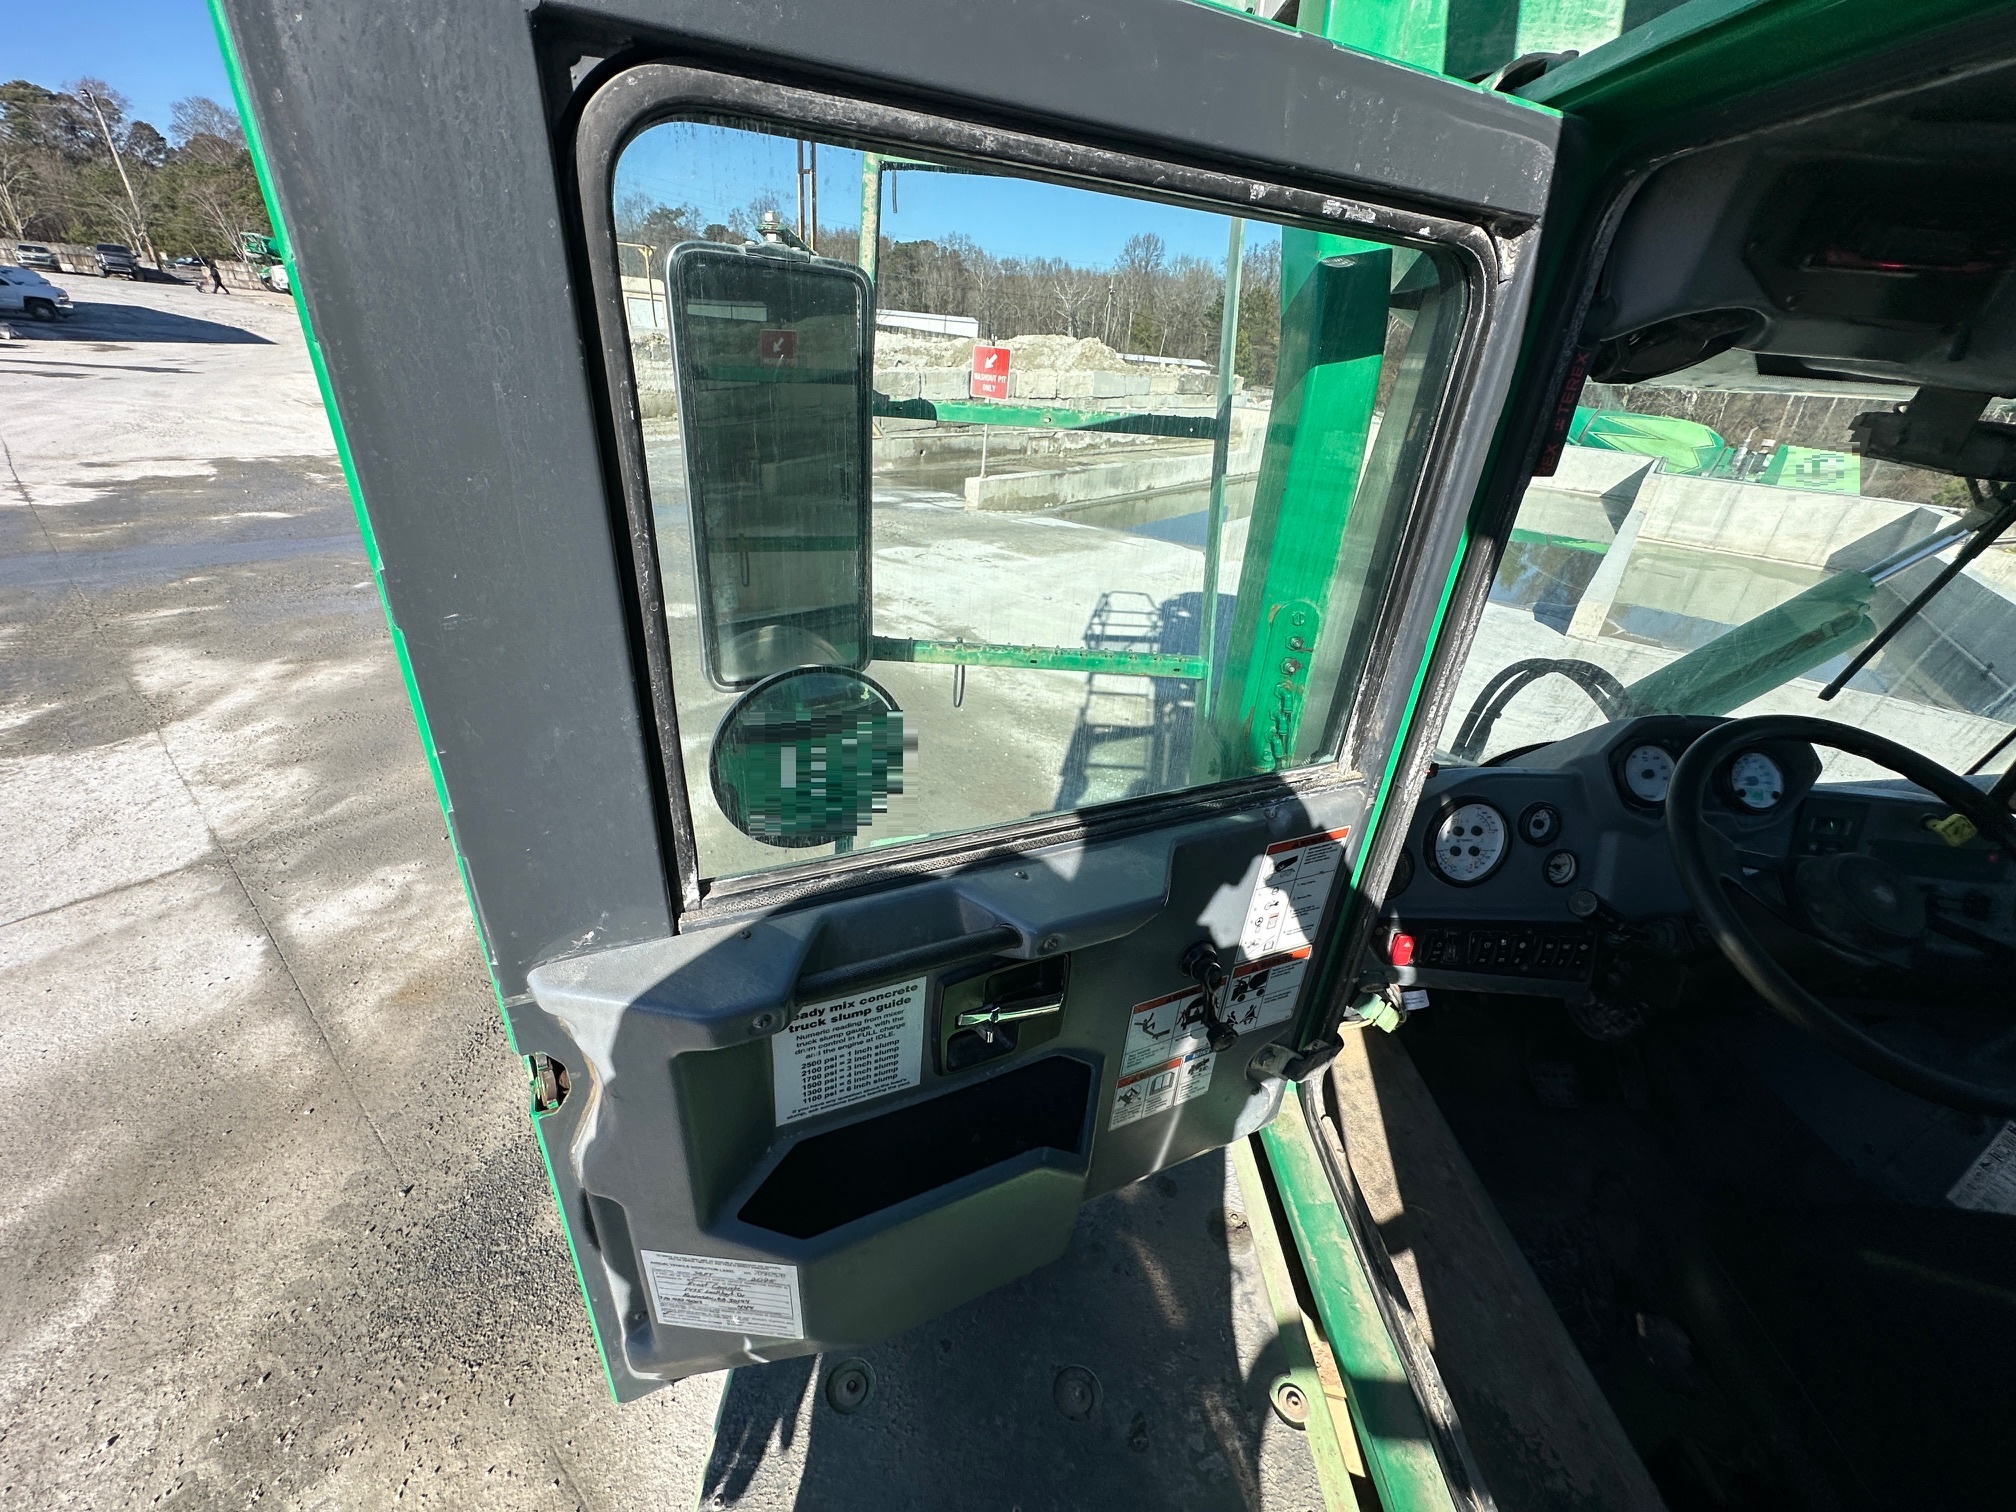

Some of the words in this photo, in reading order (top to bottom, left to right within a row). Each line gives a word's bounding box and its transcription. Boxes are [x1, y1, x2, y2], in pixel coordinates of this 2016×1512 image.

[974, 372, 997, 382] WASHOUT
[998, 375, 1007, 383] PIT
[982, 384, 996, 392] ONLY
[1557, 352, 1591, 415] TEREX
[830, 1001, 855, 1012] mix
[859, 984, 919, 1005] concrete
[788, 1018, 826, 1033] truck
[831, 1008, 871, 1023] slump
[876, 996, 912, 1012] guide
[796, 1028, 830, 1040] Numeric
[832, 1020, 862, 1032] reading
[864, 1015, 881, 1024] from
[884, 1009, 905, 1018] mixer
[794, 1046, 816, 1054] drum
[818, 1038, 846, 1048] control
[857, 1030, 878, 1039] FULL
[880, 1022, 906, 1034] charge
[796, 1039, 817, 1047] truck
[820, 1032, 843, 1043] slump
[846, 1025, 872, 1036] gauge,
[838, 1040, 864, 1051] engine
[876, 1031, 895, 1040] IDLE.
[801, 1059, 822, 1069] 2500
[824, 1056, 837, 1064] psi
[854, 1047, 872, 1055] inch
[875, 1039, 899, 1050] slump
[801, 1066, 822, 1076] 2100
[824, 1063, 837, 1072] psi
[854, 1054, 872, 1062] inch
[875, 1046, 899, 1057] slump
[802, 1074, 822, 1083] 1700
[824, 1070, 837, 1078] psi
[854, 1061, 872, 1069] inch
[874, 1053, 899, 1064] slump
[802, 1081, 822, 1090] 1500
[824, 1077, 837, 1086] psi
[854, 1068, 871, 1076] inch
[874, 1060, 898, 1071] slump
[802, 1088, 822, 1097] 1300
[824, 1084, 837, 1092] psi
[854, 1075, 871, 1083] inch
[874, 1067, 898, 1078] slump
[802, 1095, 822, 1104] 1100
[825, 1091, 837, 1099] psi
[854, 1081, 871, 1090] inch
[873, 1073, 898, 1084] slump
